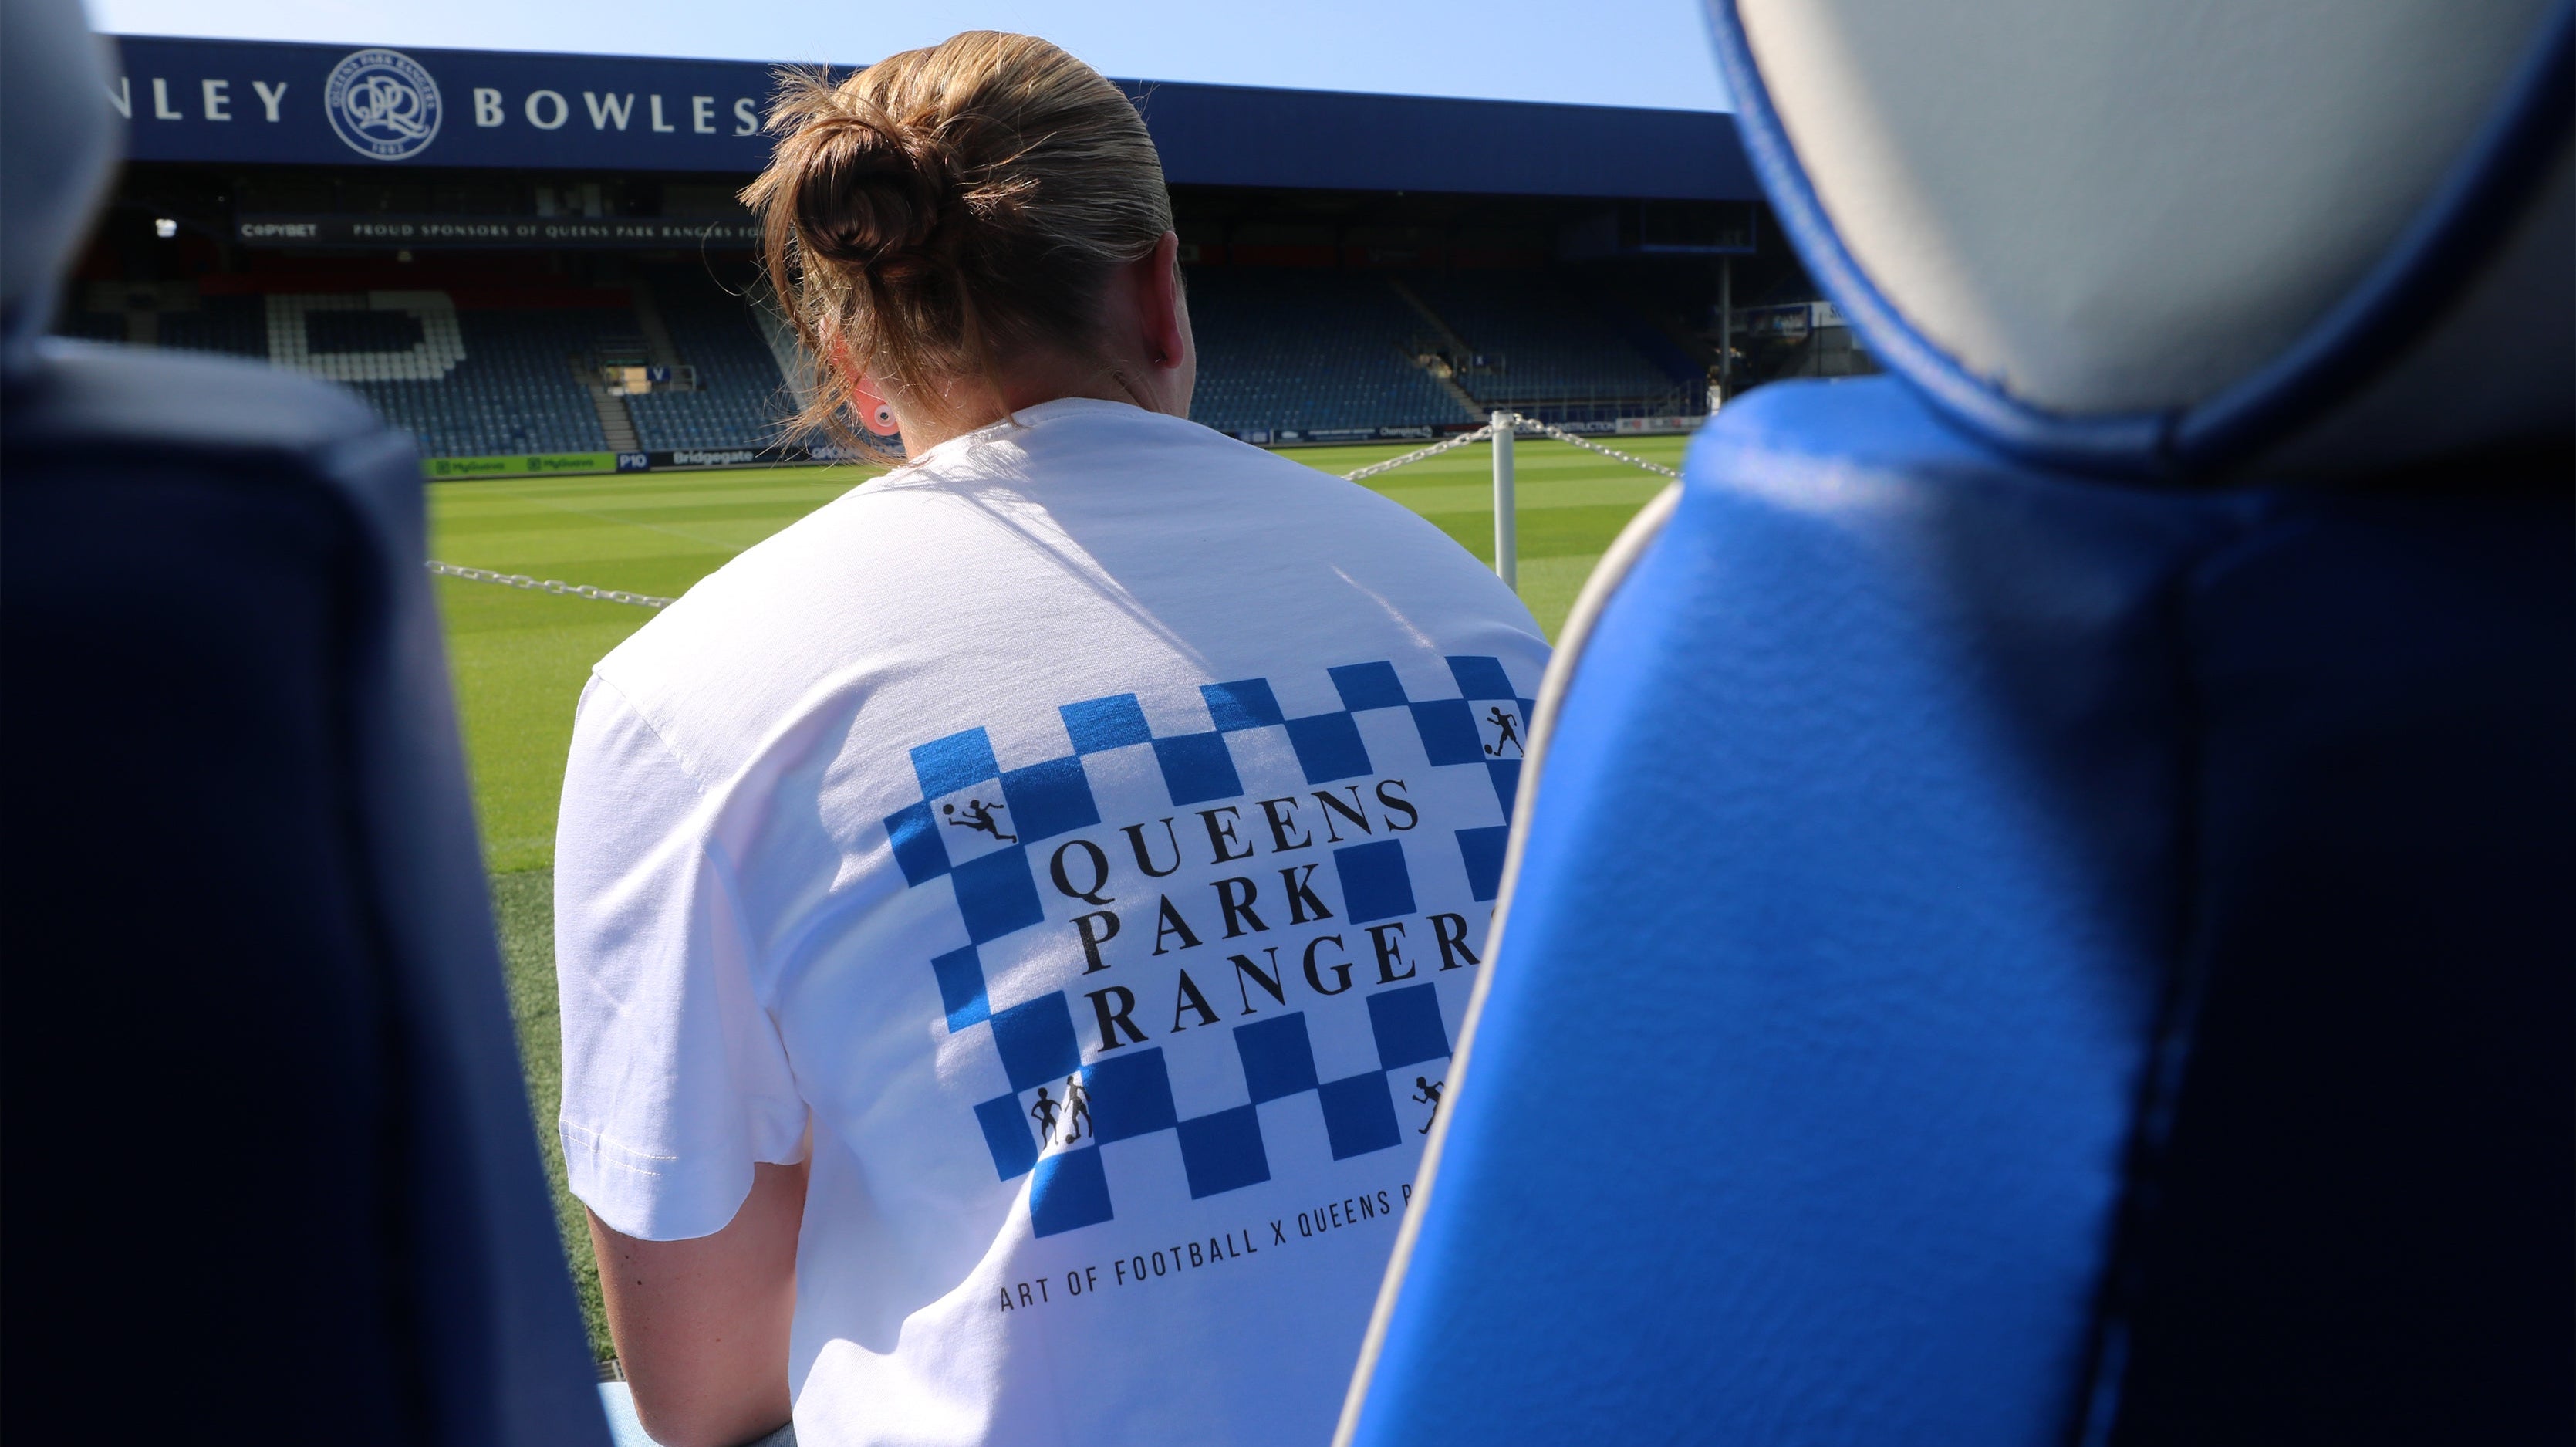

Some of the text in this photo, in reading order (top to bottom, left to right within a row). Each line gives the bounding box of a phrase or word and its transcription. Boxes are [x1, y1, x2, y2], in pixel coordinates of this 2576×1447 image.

[359, 54, 395, 66] PARK
[103, 76, 759, 136] NLEY BOWLES
[353, 224, 414, 236] PROUD
[420, 225, 510, 237] SPONSORS
[516, 225, 538, 237] OF
[545, 225, 609, 238] QUEENS
[616, 226, 654, 238] PARK
[662, 226, 732, 238] RANGERS
[620, 454, 647, 467] P10
[673, 450, 754, 465] Bridgegate
[1049, 779, 1419, 906] QUEENS
[1069, 863, 1334, 975] PARK
[1083, 906, 1497, 1053] RANGER
[1000, 1278, 1050, 1311] ART
[1067, 1266, 1099, 1296] OF
[1114, 1229, 1258, 1286] FOOTBALL
[1270, 1219, 1287, 1246] X
[1298, 1191, 1390, 1237] QUEENS
